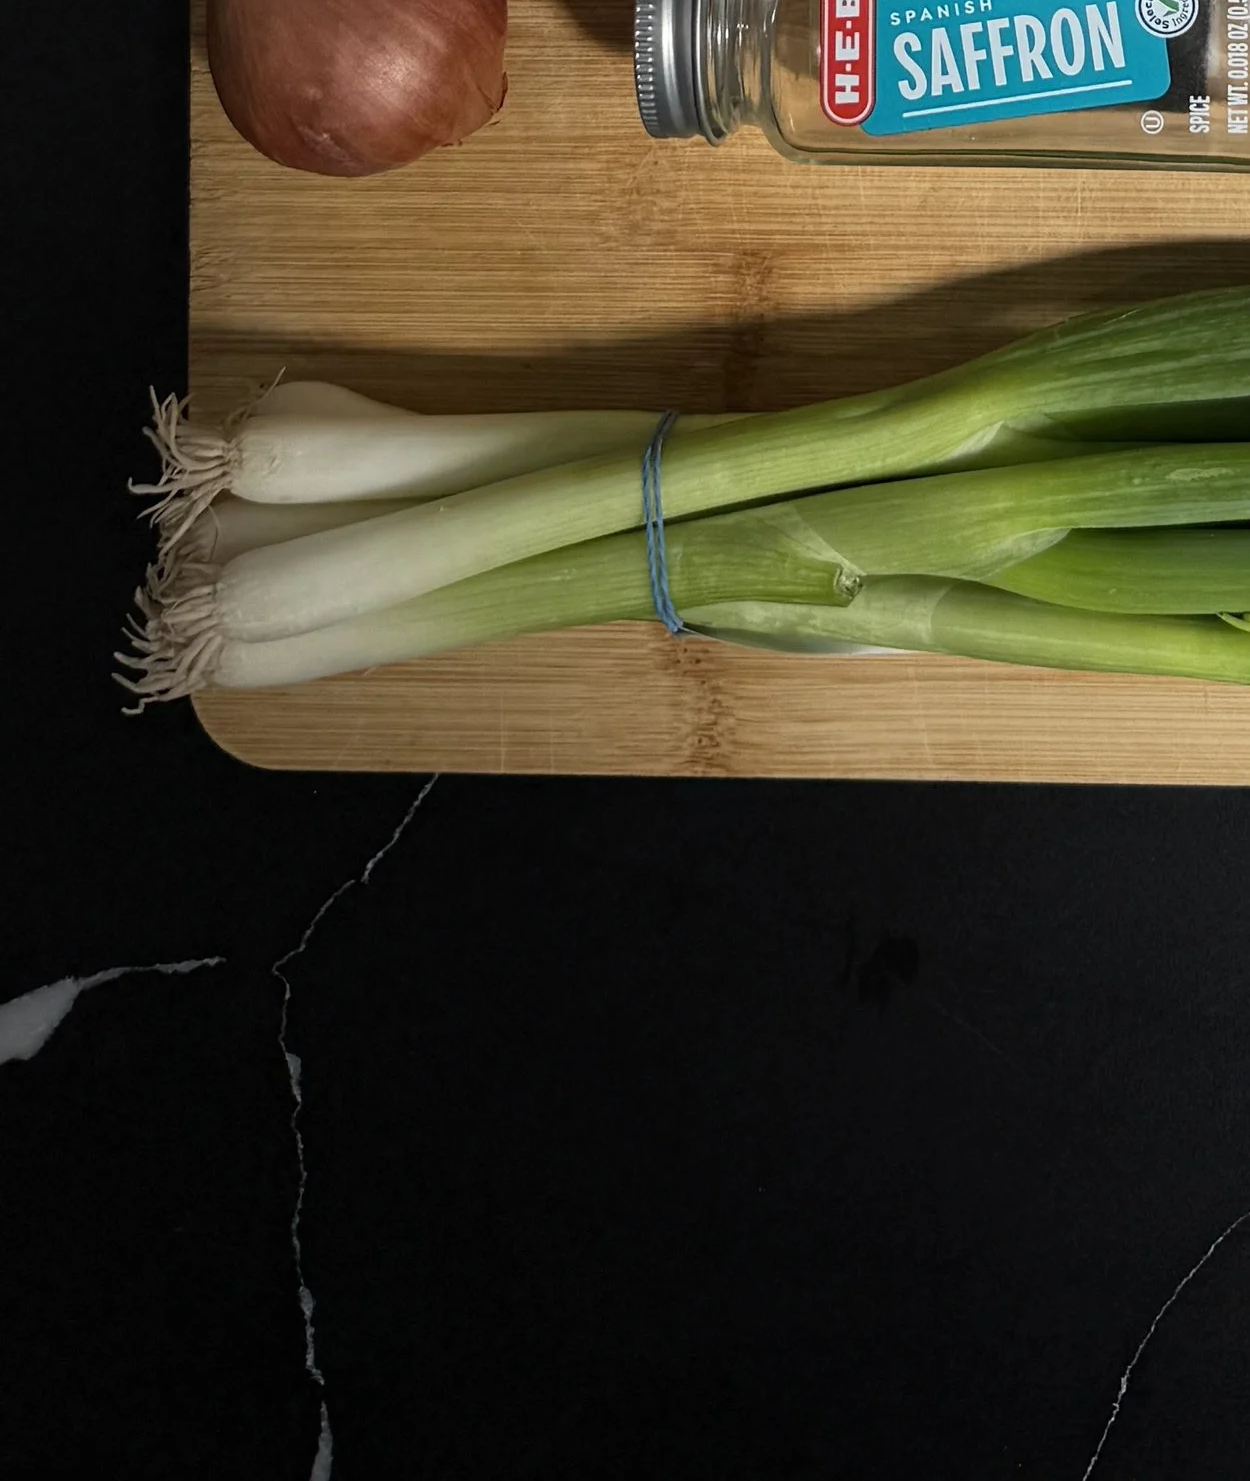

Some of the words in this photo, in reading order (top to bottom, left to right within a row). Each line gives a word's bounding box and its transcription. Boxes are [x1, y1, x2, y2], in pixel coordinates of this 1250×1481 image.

[1228, 24, 1248, 39] OZ
[893, 0, 1125, 100] SAFFRON
[1228, 43, 1248, 79] 0.018
[1228, 83, 1248, 105] WT.
[1190, 95, 1210, 133] SPICE
[1228, 107, 1248, 133] NET
